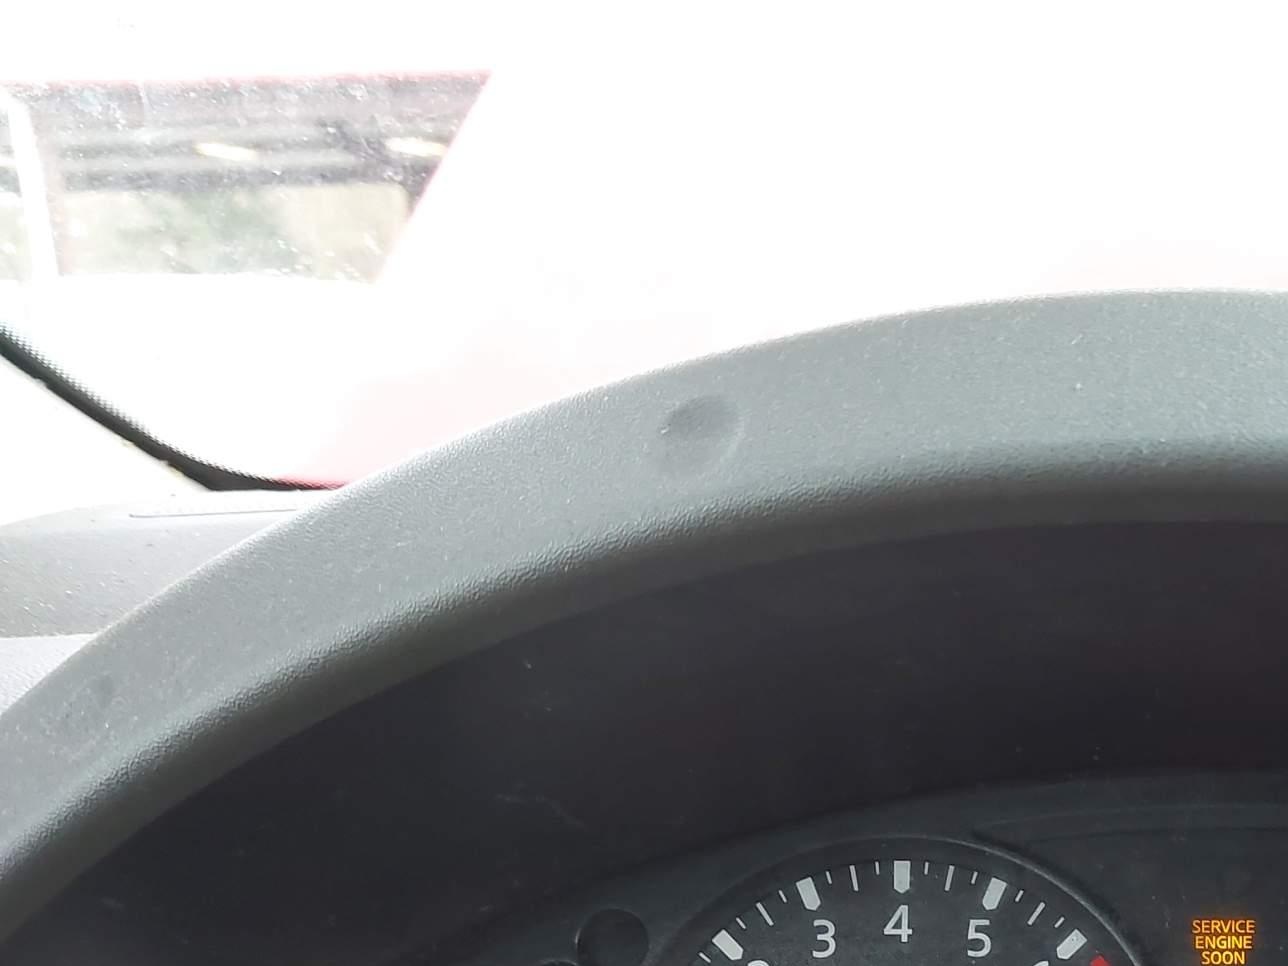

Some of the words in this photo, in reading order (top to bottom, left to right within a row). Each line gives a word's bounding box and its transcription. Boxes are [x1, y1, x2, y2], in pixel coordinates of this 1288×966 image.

[883, 904, 913, 942] 4
[1191, 919, 1256, 934] SERVICE
[812, 919, 836, 958] 3
[967, 919, 992, 958] 5
[1195, 935, 1253, 949] ENGINE
[1201, 950, 1246, 965] SOON
